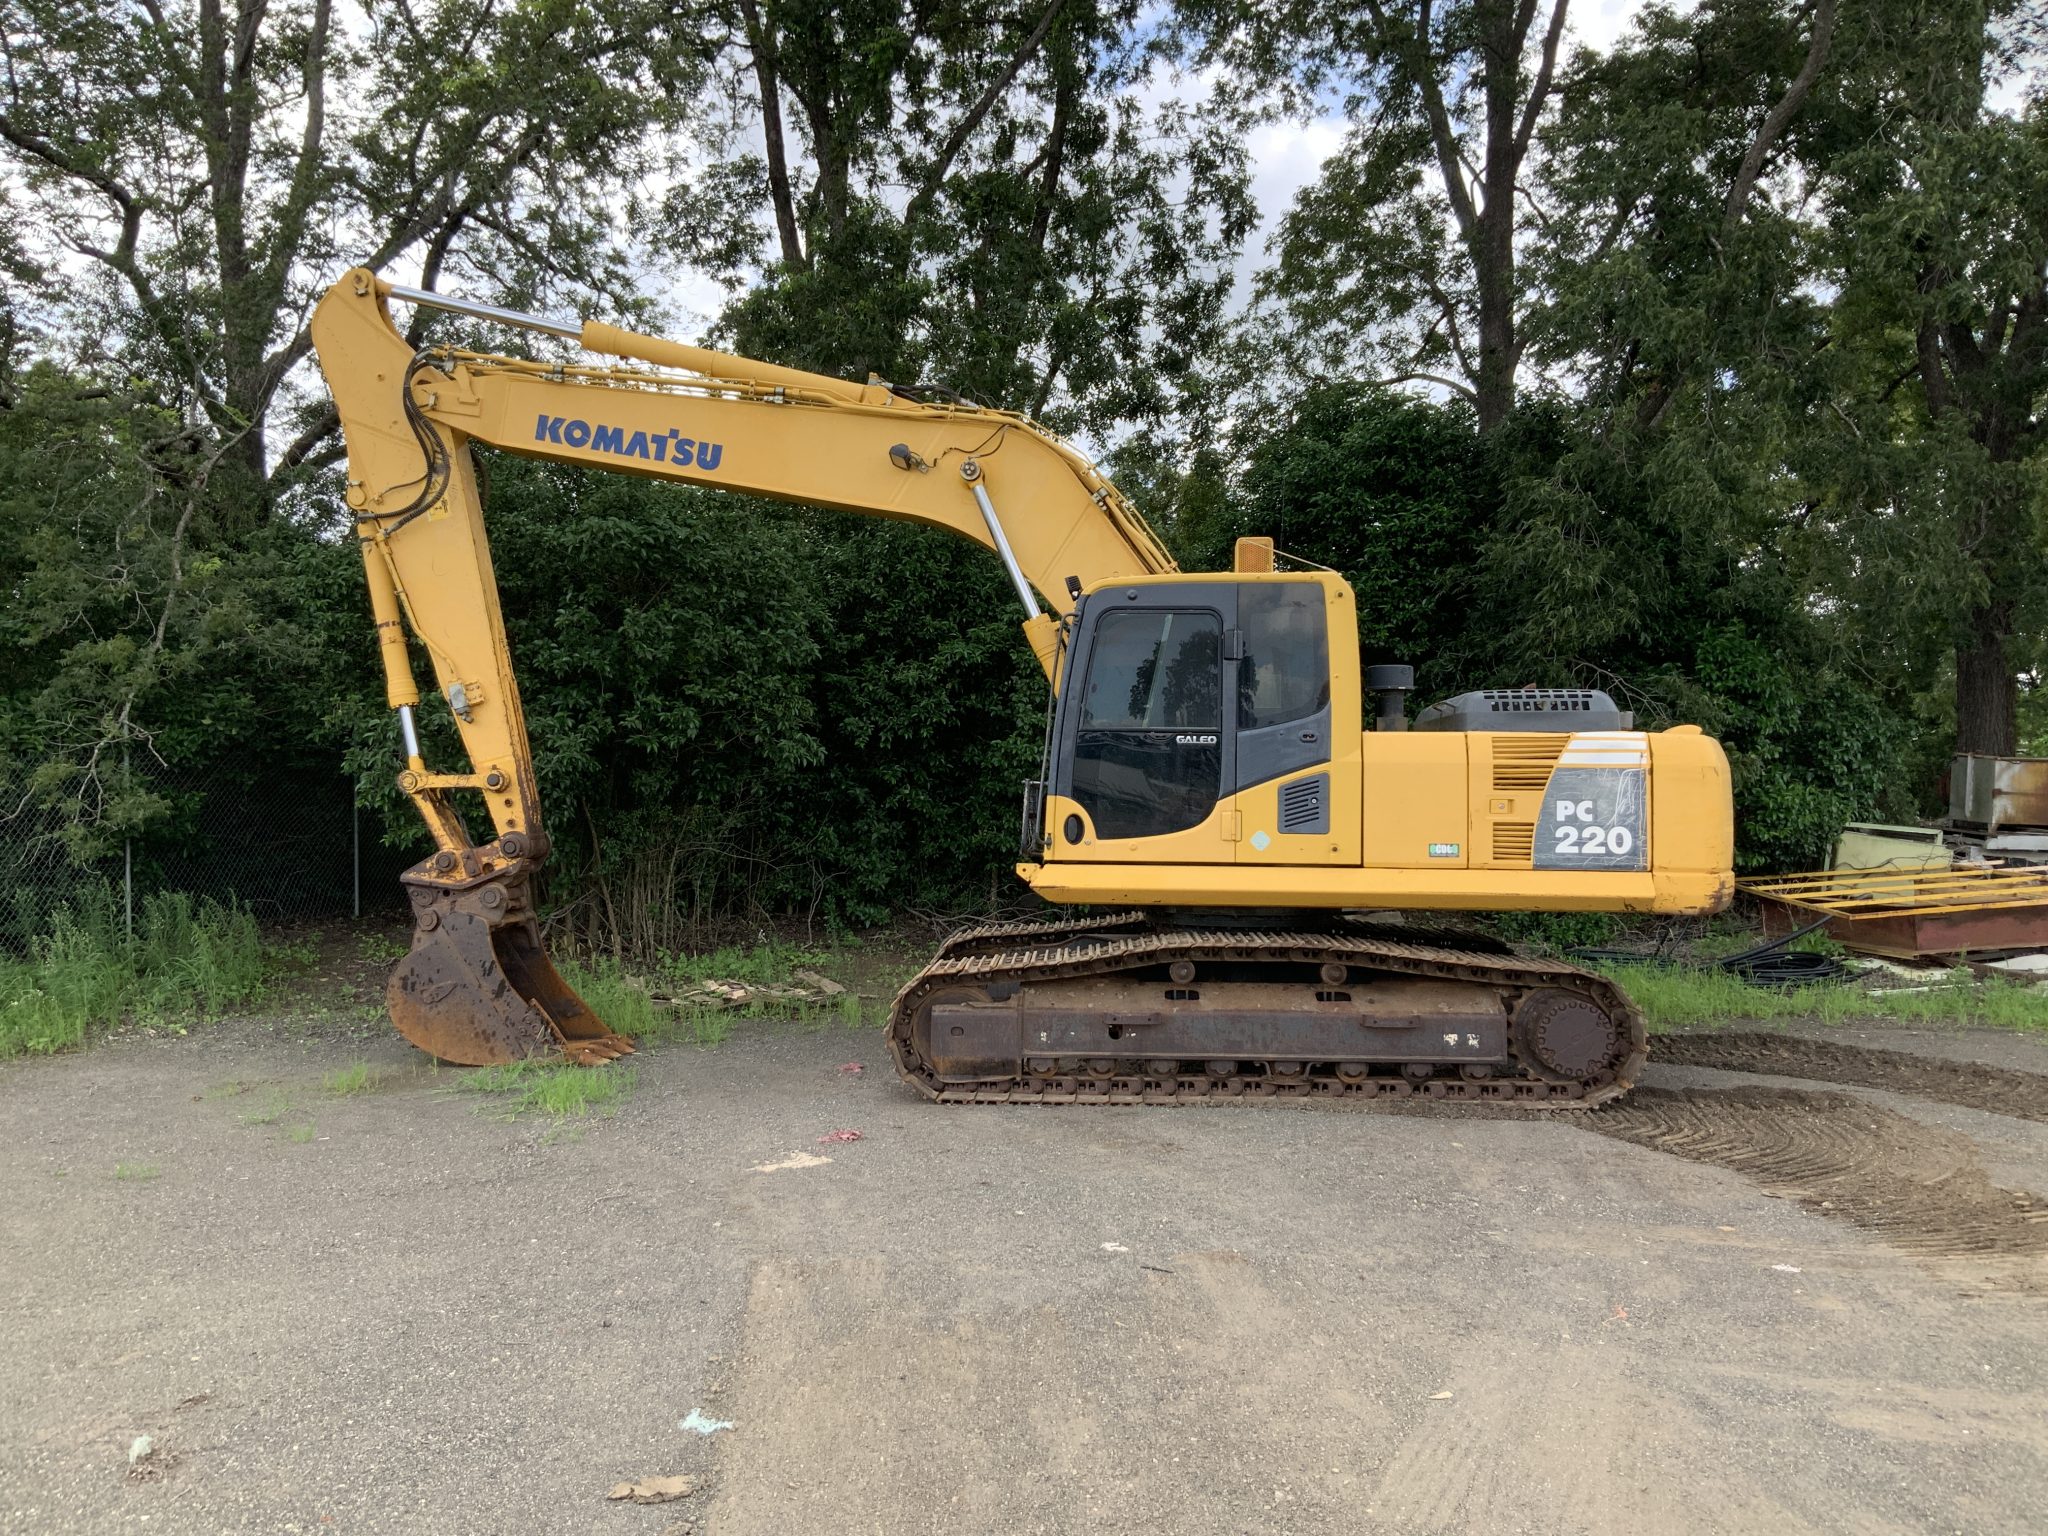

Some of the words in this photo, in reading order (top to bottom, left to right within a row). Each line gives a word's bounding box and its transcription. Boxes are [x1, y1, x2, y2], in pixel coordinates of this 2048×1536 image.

[535, 414, 723, 471] KOMATSU
[1176, 735, 1217, 744] GALEO
[1556, 800, 1593, 822] PC
[1555, 825, 1633, 855] 220
